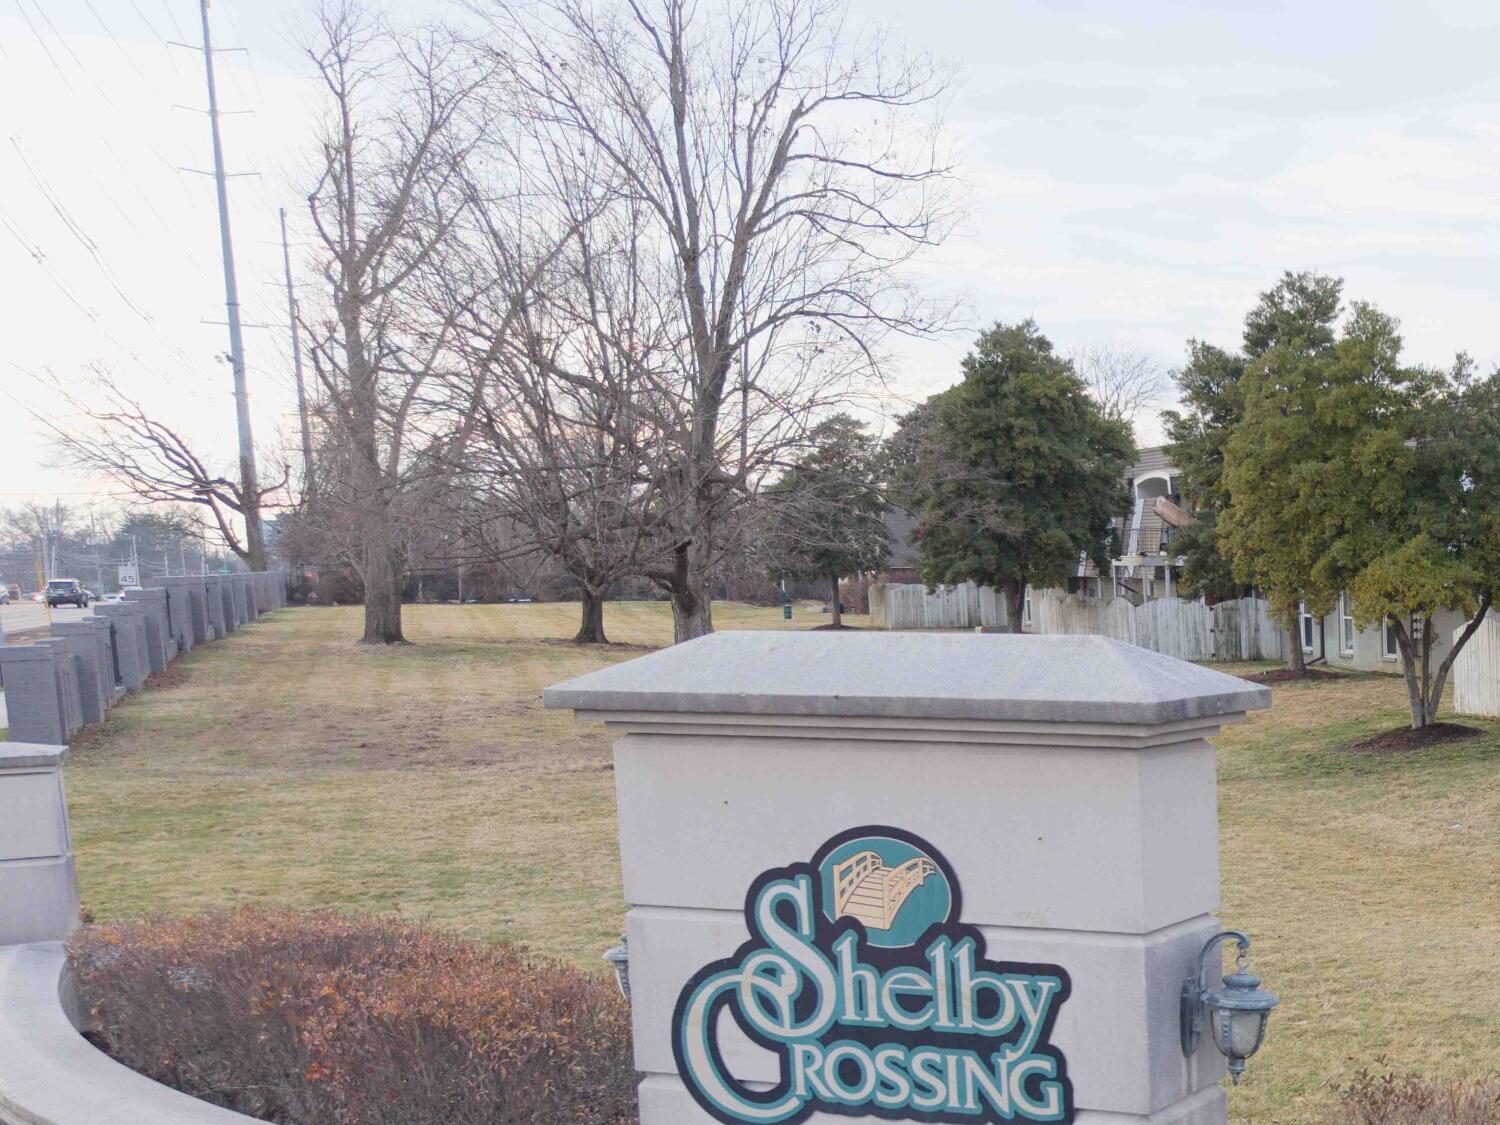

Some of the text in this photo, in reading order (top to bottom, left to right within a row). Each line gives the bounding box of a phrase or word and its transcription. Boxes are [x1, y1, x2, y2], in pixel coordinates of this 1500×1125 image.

[121, 575, 136, 583] 45
[738, 877, 1058, 1061] Shelby
[684, 972, 1060, 1119] CROSSING
